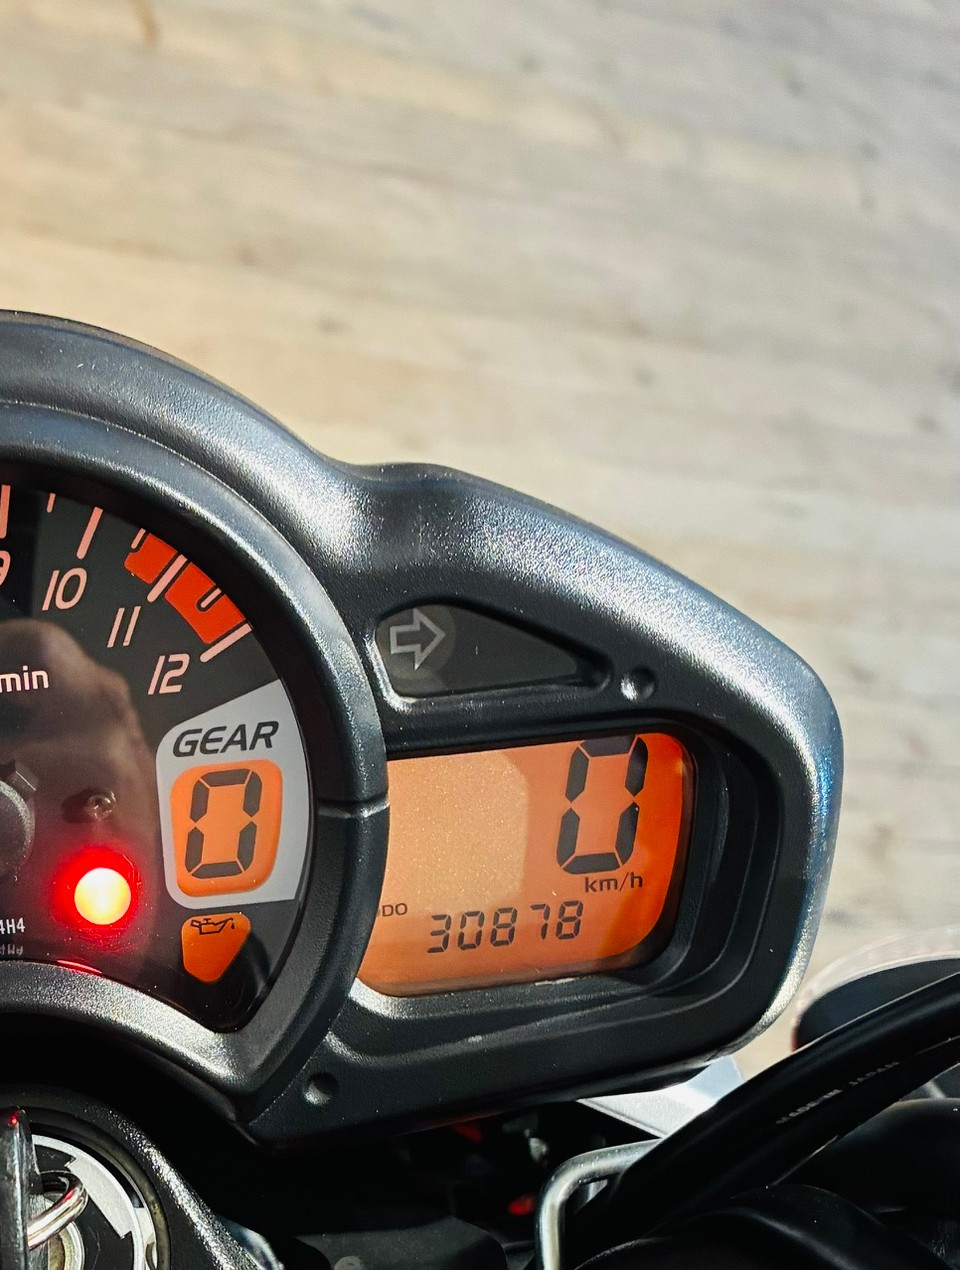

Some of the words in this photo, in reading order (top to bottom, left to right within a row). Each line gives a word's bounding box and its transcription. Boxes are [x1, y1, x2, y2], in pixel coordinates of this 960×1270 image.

[42, 567, 87, 611] 10
[106, 605, 141, 648] 11
[147, 653, 190, 695] 12
[172, 720, 279, 758] GEAR
[184, 768, 263, 880] 0
[556, 734, 649, 875] 0
[584, 871, 643, 893] km/h
[377, 902, 408, 918] DO
[426, 900, 584, 954] 30878
